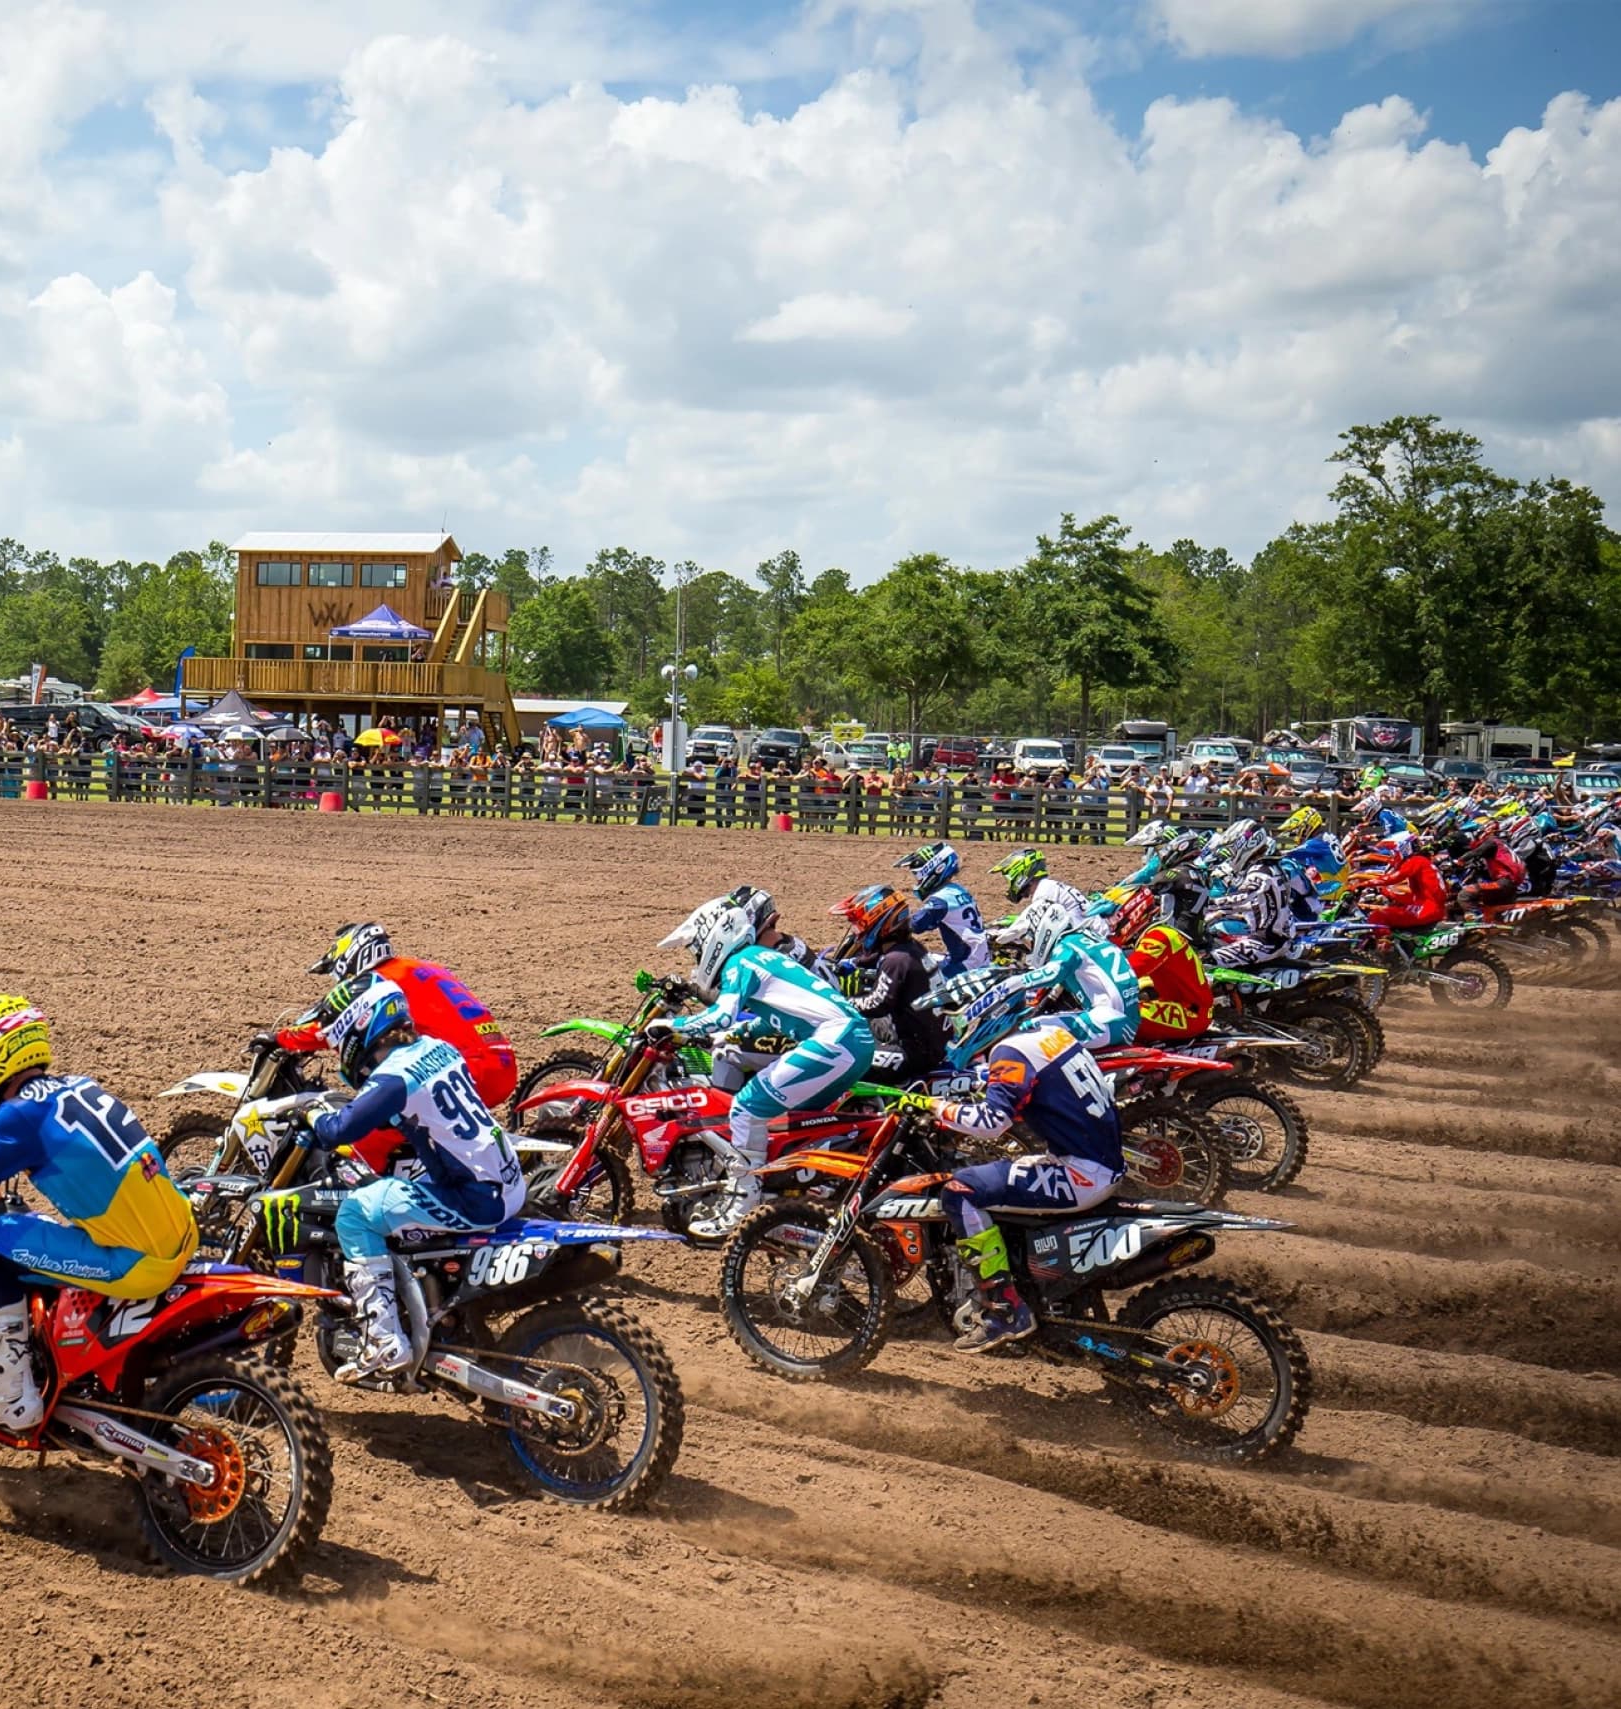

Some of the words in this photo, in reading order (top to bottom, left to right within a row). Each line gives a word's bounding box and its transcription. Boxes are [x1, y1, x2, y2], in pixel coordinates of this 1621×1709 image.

[1429, 933, 1459, 949] 346
[625, 1092, 708, 1117] GEICO
[800, 1115, 839, 1127] HONDA
[53, 1080, 152, 1171] 12
[1006, 1163, 1075, 1201] FXR
[573, 1227, 647, 1239] DUNLOP
[1068, 1223, 1141, 1274] 500
[467, 1244, 534, 1287] 936
[107, 1296, 158, 1338] 12
